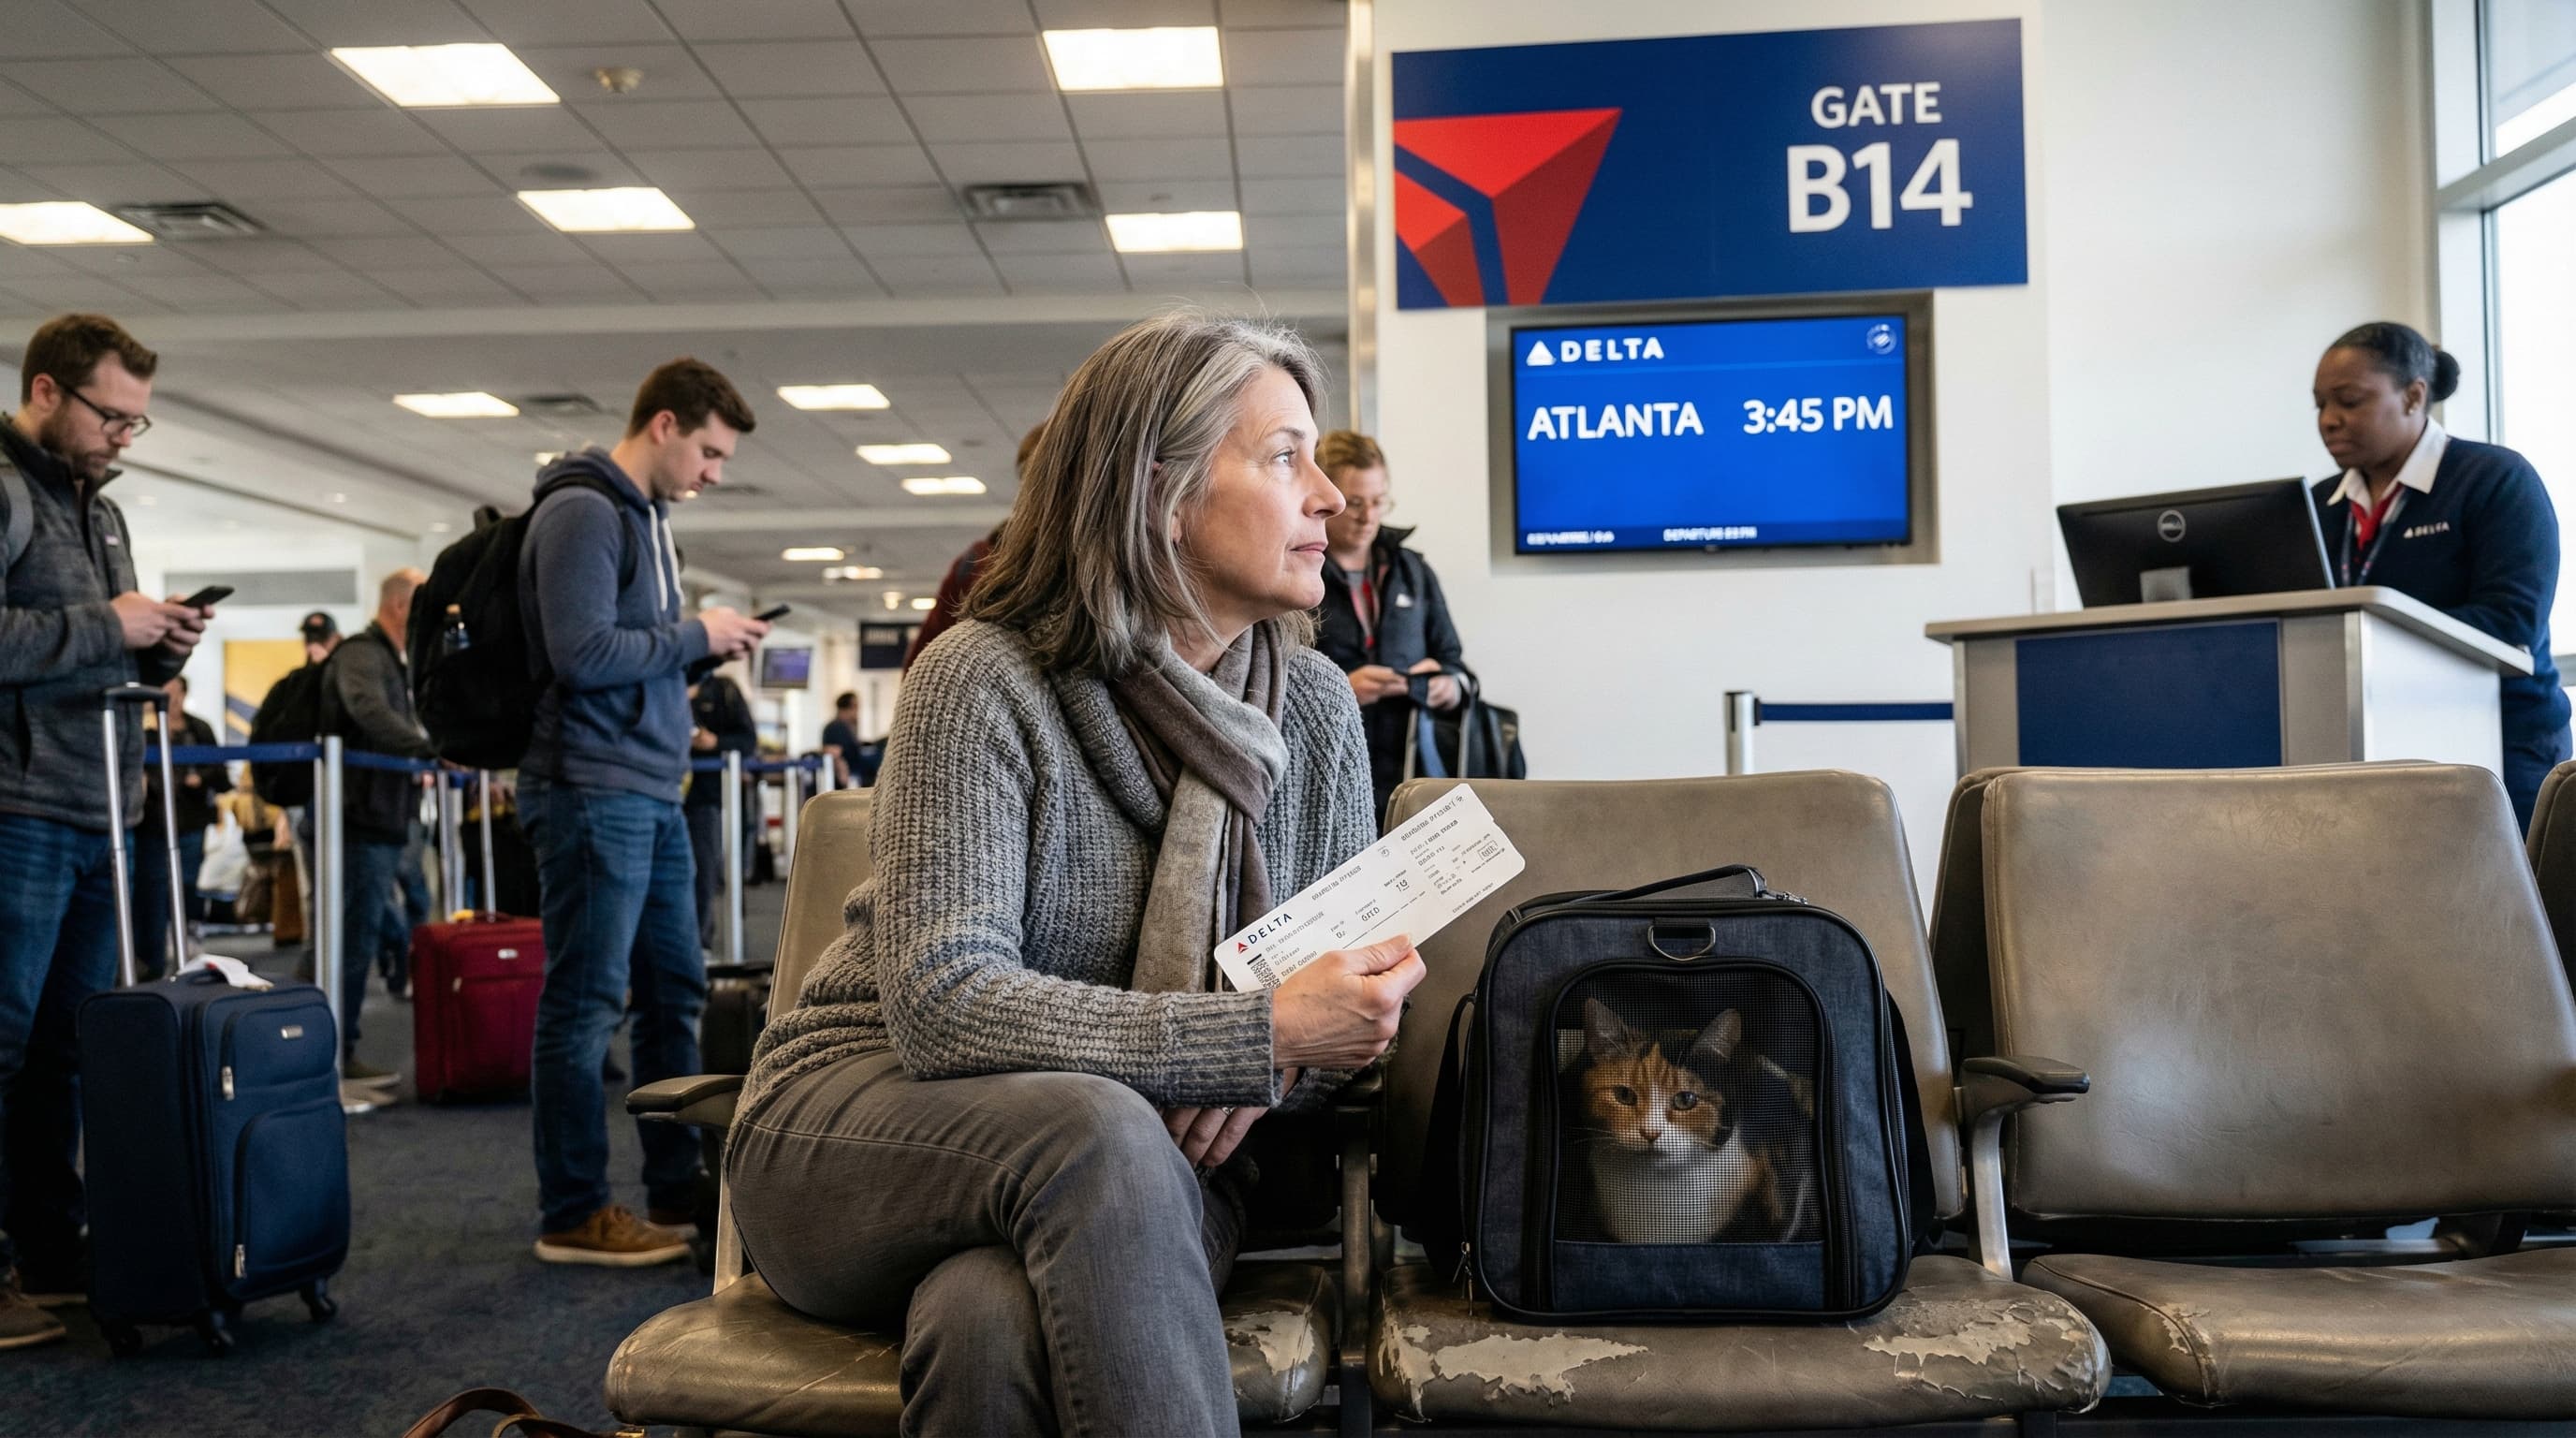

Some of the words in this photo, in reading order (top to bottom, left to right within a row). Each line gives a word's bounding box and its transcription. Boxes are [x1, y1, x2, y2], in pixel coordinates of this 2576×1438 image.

[1810, 81, 1942, 129] GATE
[1786, 139, 1974, 234] B14
[1560, 336, 1665, 363] DELTA
[1527, 402, 1705, 441] ATLANTA
[1742, 397, 1824, 434] 3:45
[1832, 394, 1895, 432] PM
[1247, 913, 1293, 945] DELTA
